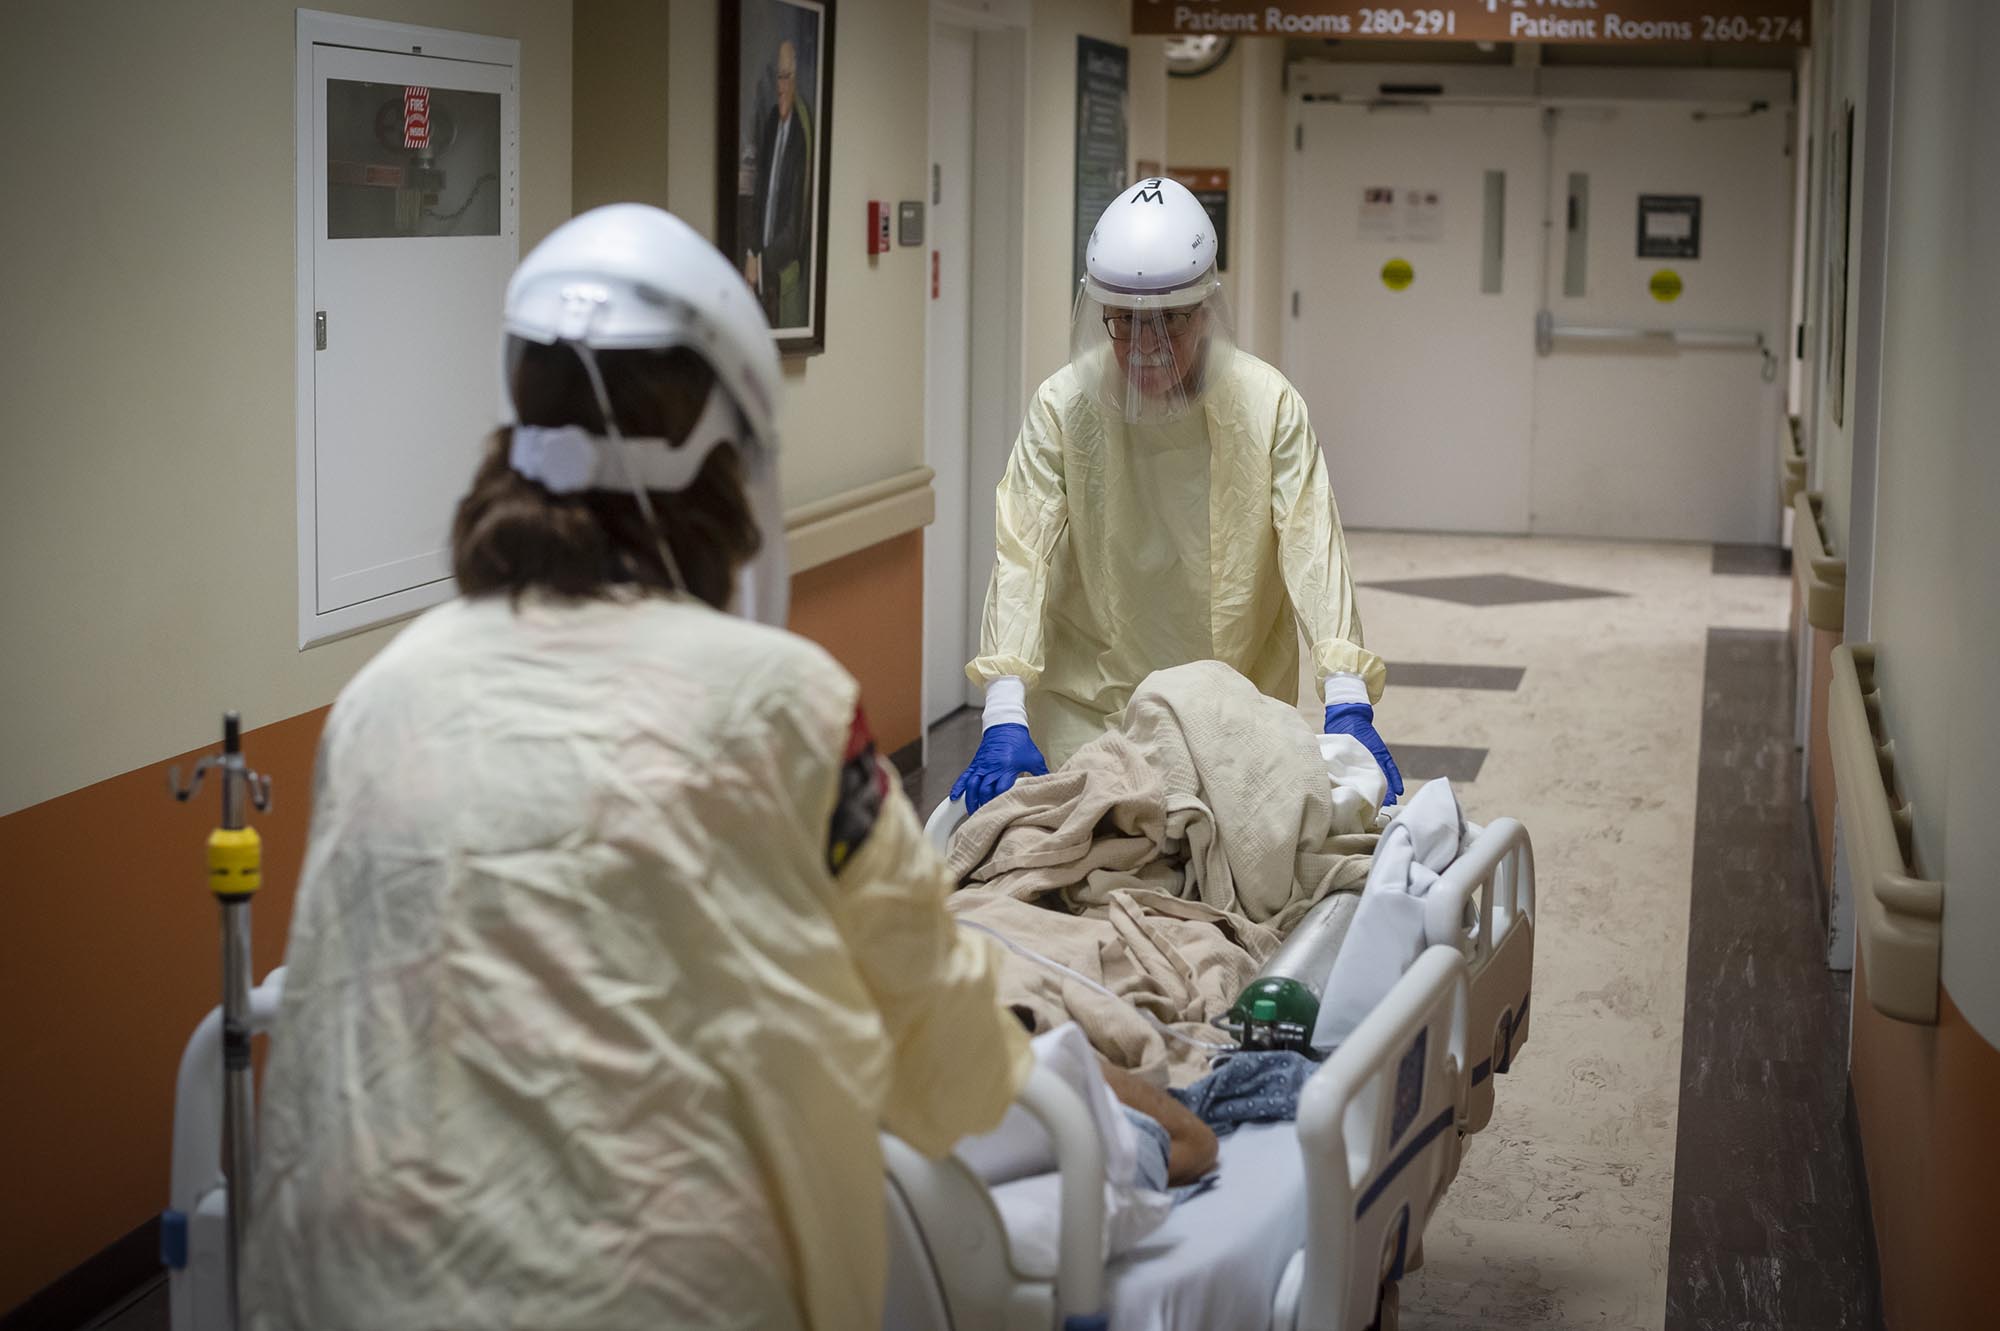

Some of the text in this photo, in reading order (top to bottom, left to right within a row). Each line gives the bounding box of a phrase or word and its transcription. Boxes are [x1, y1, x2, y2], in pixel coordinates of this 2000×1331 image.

[1173, 7, 1455, 34] Patient Rooms 280-291
[1509, 11, 1803, 42] Patient Rooms 260-274
[410, 98, 425, 112] FIRE
